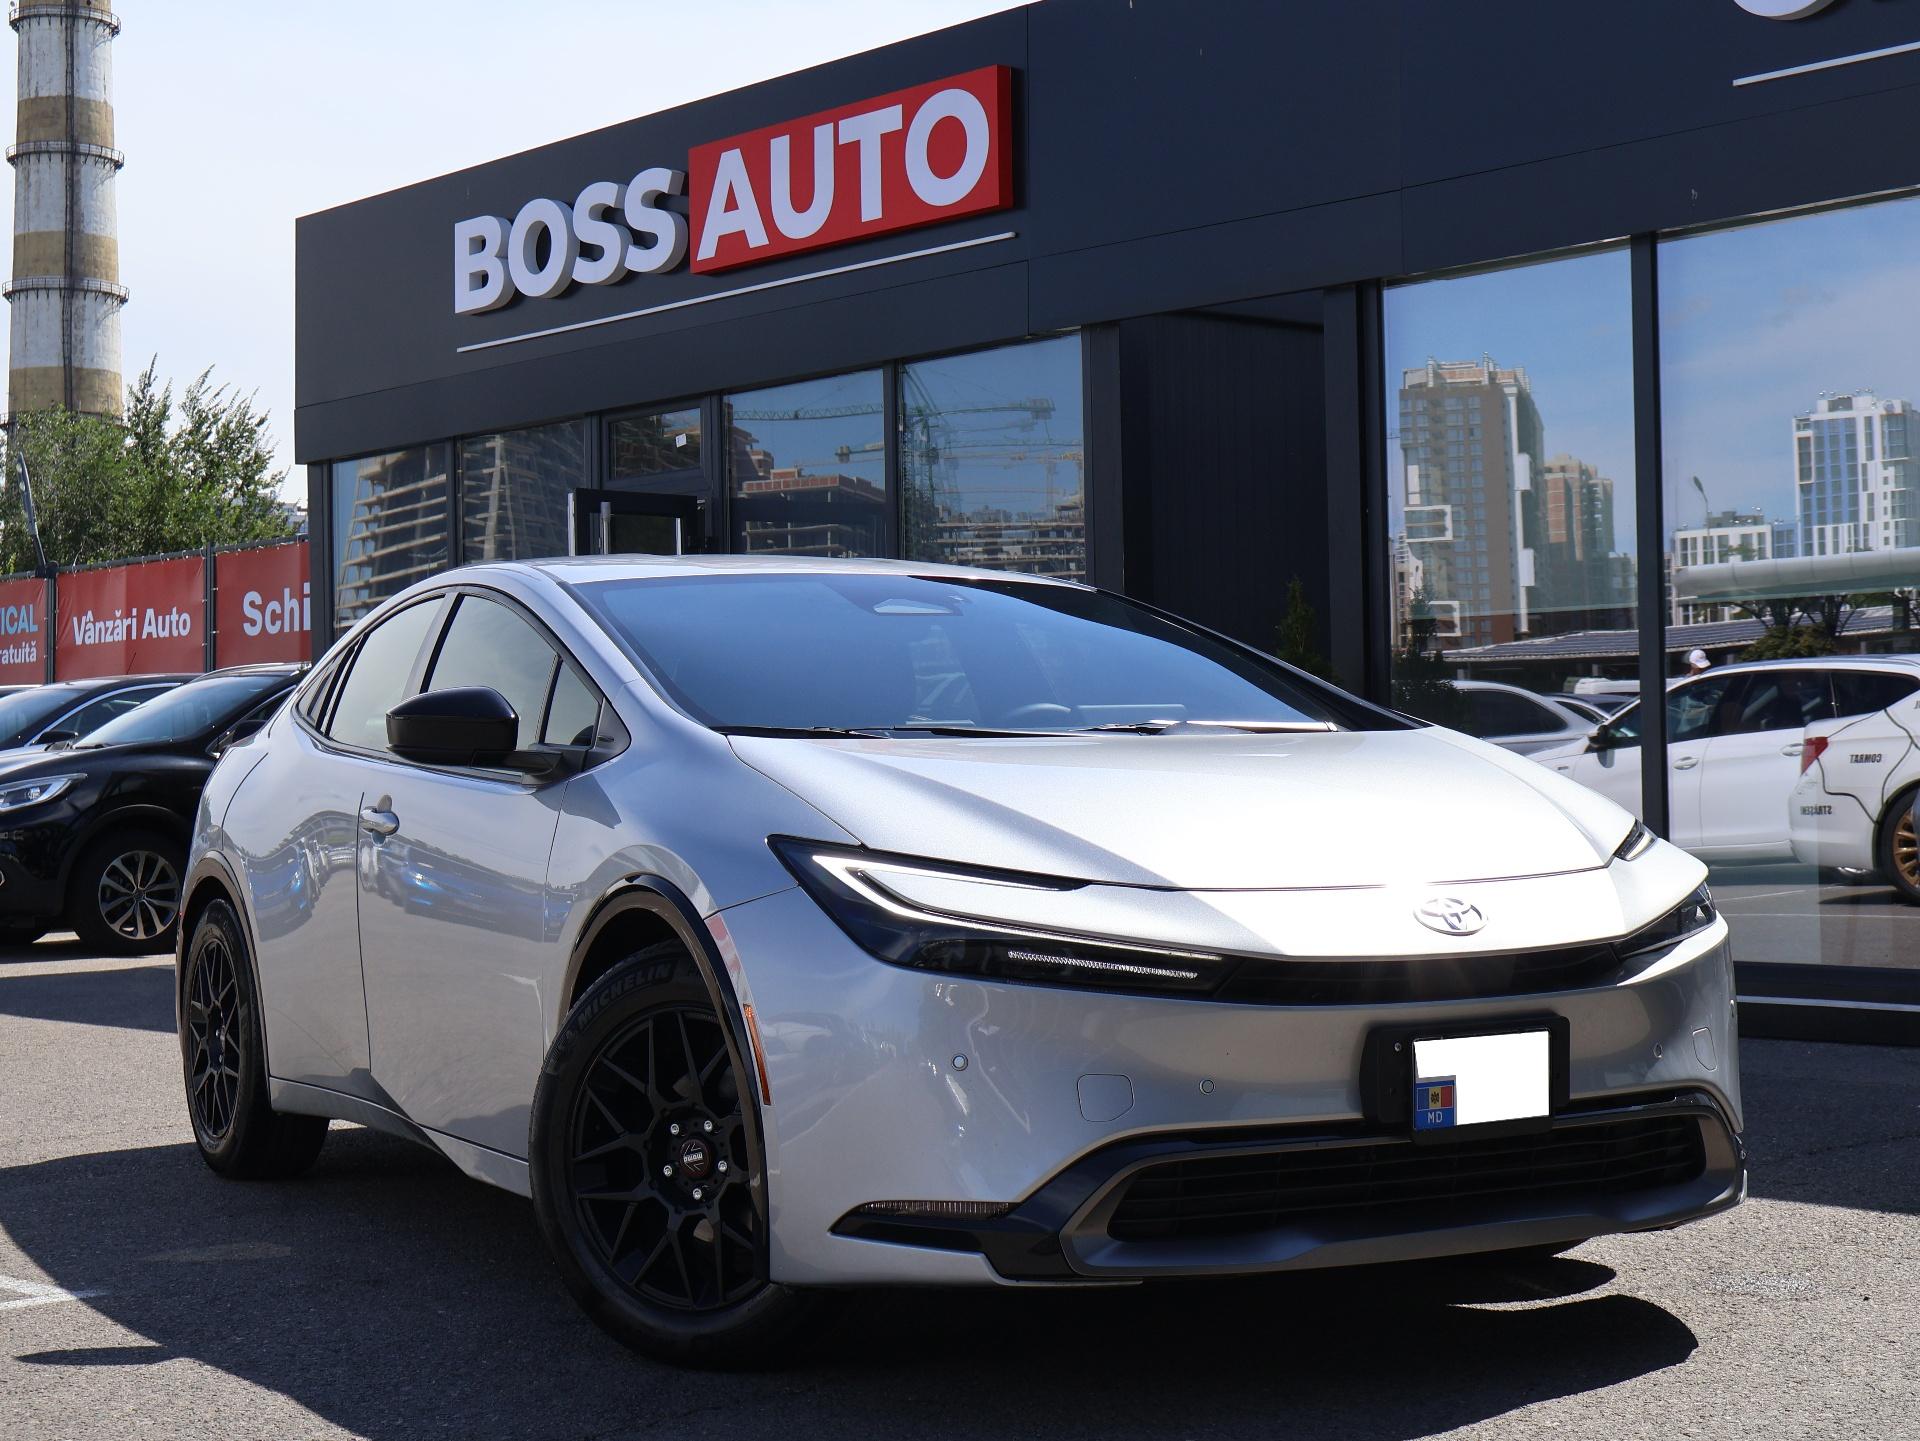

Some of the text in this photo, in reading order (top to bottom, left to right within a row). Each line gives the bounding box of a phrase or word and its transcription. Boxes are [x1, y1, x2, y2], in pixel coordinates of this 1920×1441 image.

[454, 88, 990, 315] BOSS AUTO
[0, 604, 38, 635] ICAL
[73, 606, 191, 645] Vânzări Auto
[243, 582, 311, 636] Schi
[577, 965, 672, 1028] MICHELIN
[1427, 1111, 1443, 1124] MD
